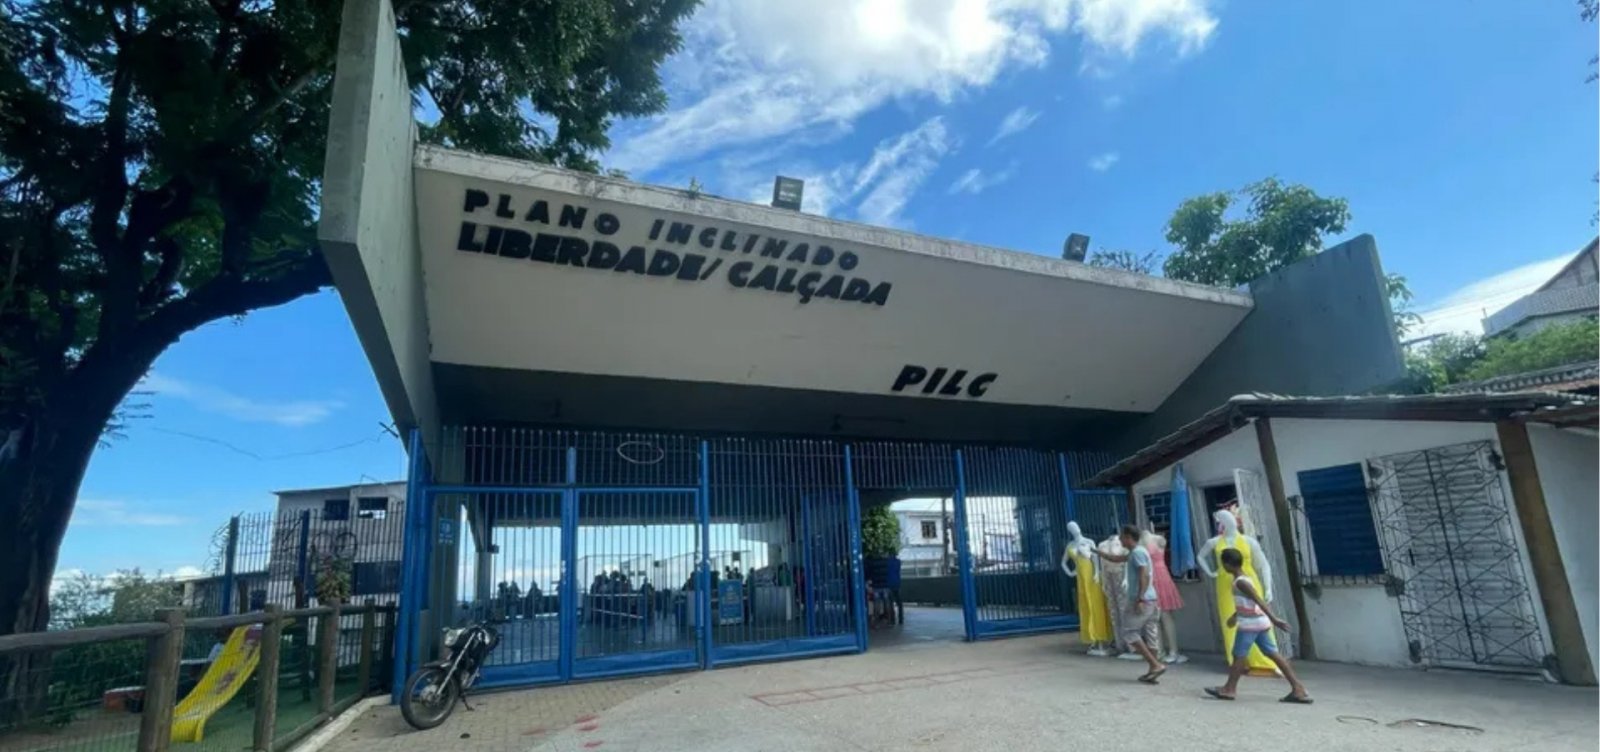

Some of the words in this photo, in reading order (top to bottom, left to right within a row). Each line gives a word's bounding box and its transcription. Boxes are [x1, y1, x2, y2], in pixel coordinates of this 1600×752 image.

[463, 188, 620, 235] PLANO
[648, 219, 859, 270] INCLINADO
[728, 261, 892, 305] CALÇADA
[891, 365, 998, 397] PILC
